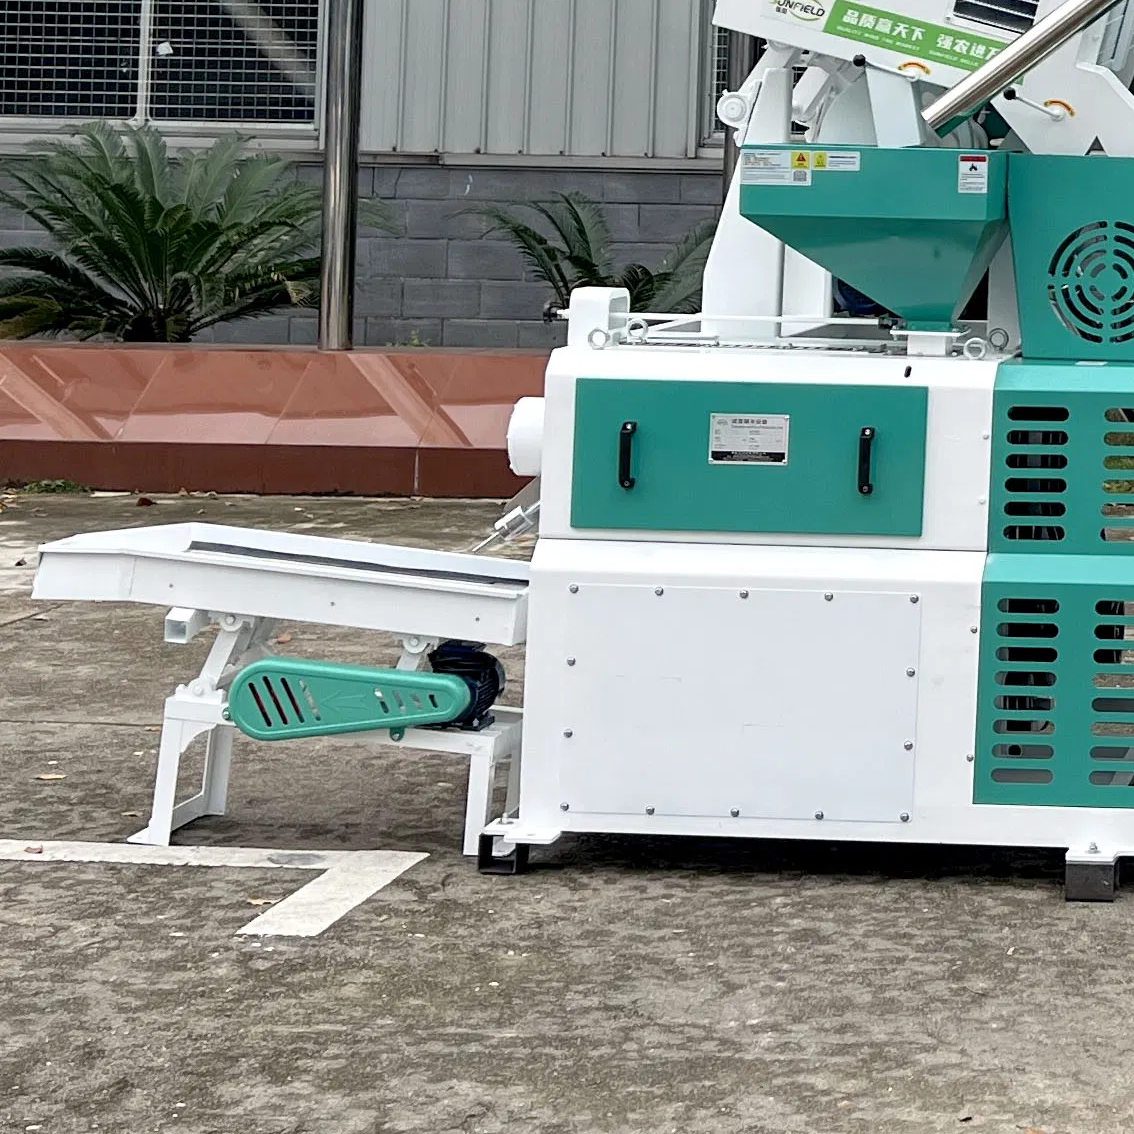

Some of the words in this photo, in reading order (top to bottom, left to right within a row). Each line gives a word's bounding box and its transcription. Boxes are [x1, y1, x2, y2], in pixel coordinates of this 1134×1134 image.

[842, 8, 926, 41] 品质赢天下
